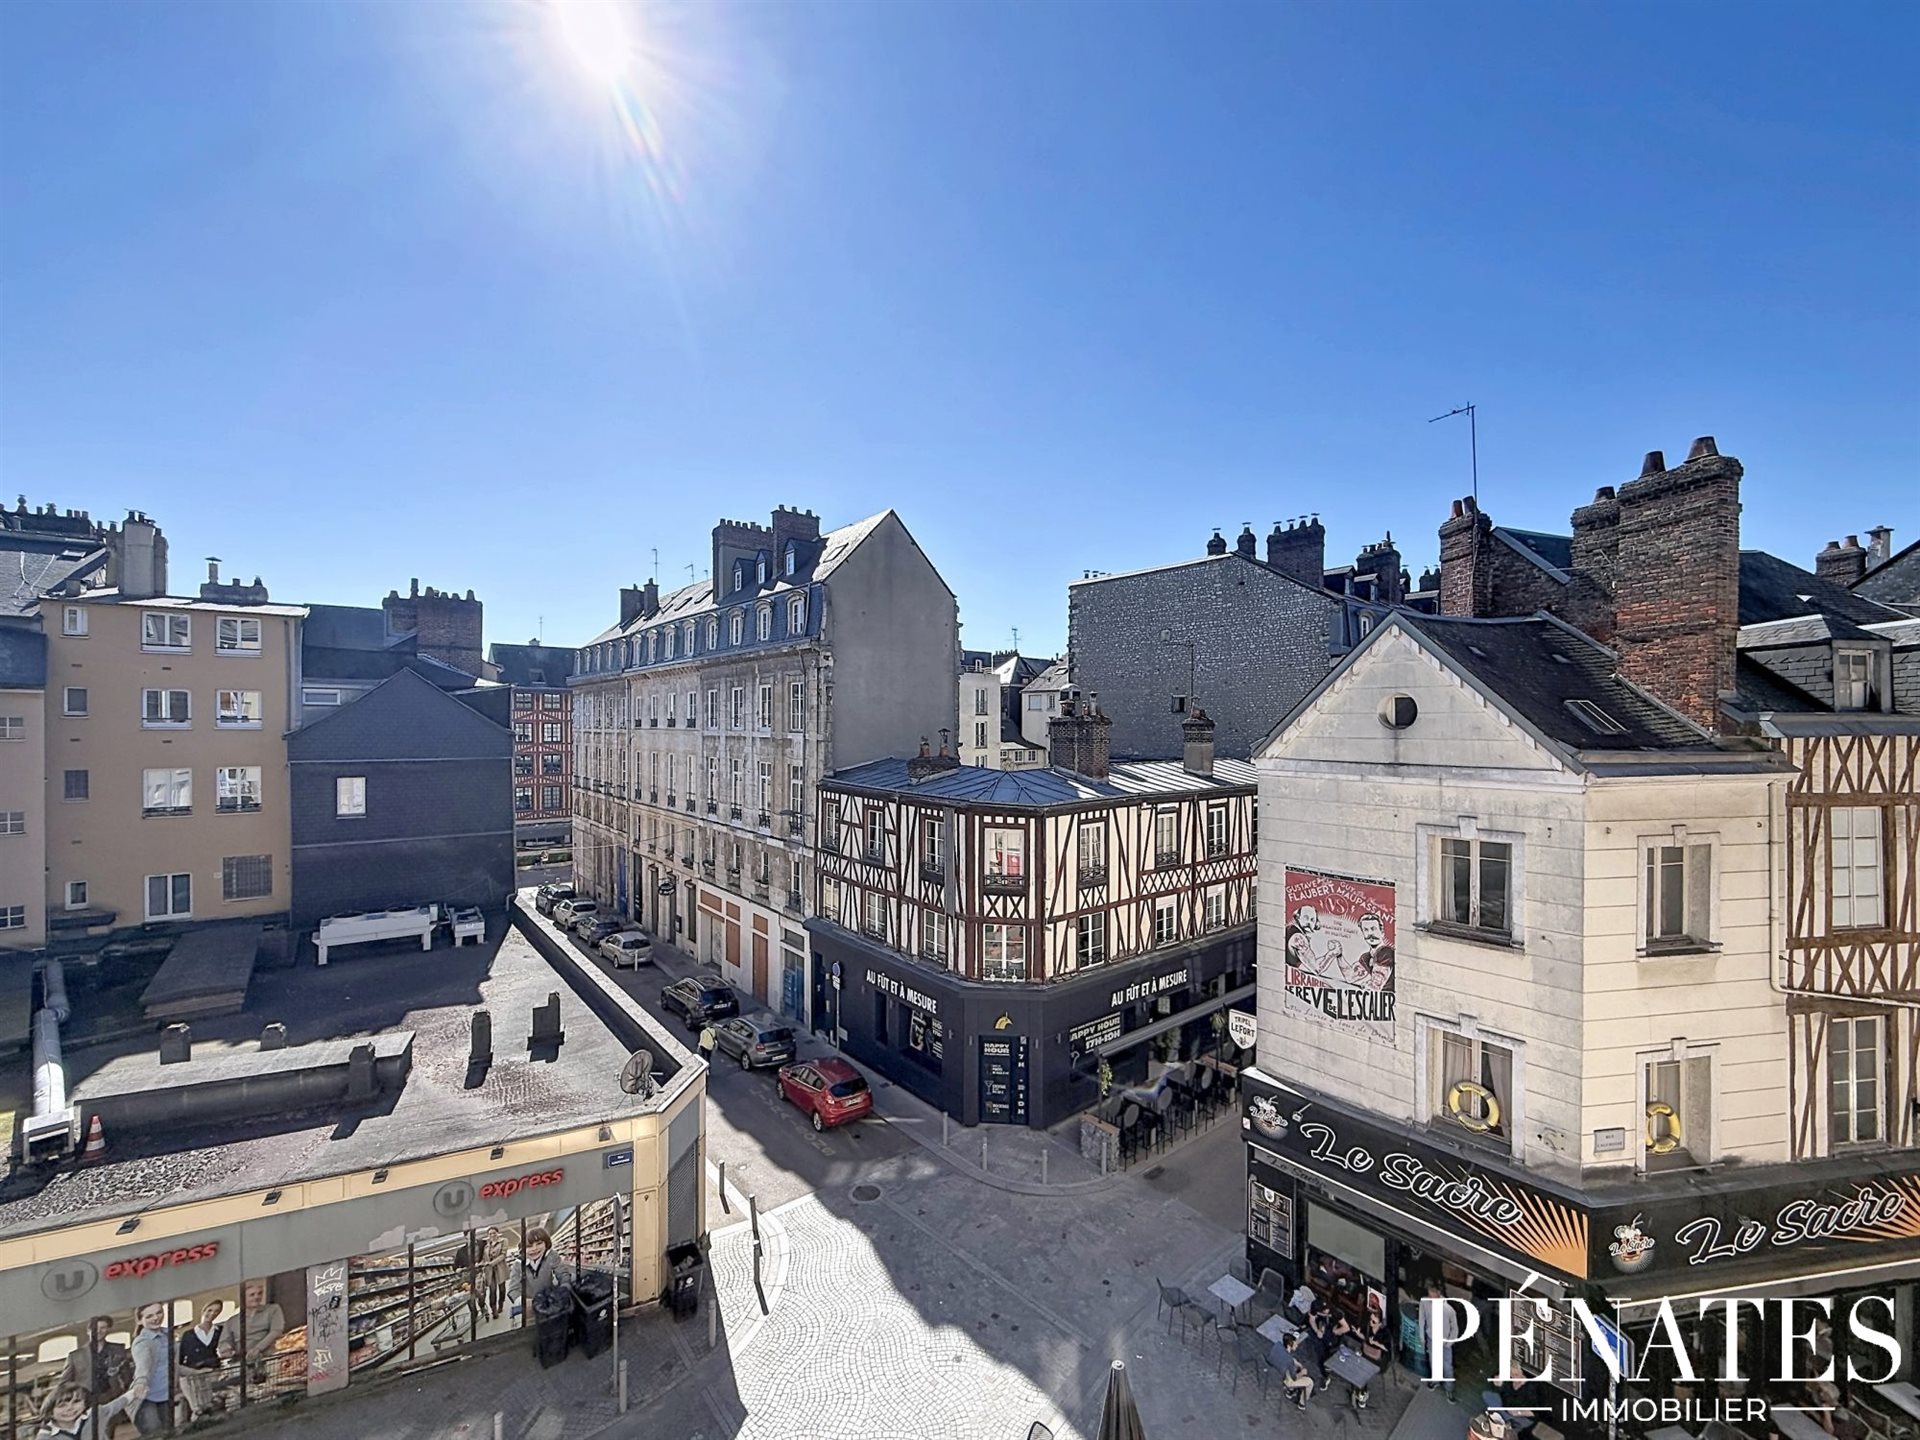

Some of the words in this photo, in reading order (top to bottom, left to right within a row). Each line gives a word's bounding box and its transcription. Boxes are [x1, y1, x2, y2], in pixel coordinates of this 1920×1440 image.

[1286, 880, 1317, 893] GUSTAVE
[1288, 883, 1335, 902] FLAUBERT
[1340, 881, 1354, 892] GUY
[1336, 887, 1394, 924] MAUPASSANT
[866, 969, 876, 984] AU
[877, 972, 889, 991] FÛT
[890, 980, 898, 995] ET
[899, 981, 905, 999] À
[906, 987, 936, 1014] MESURE
[1111, 990, 1124, 1007] AU
[1126, 984, 1140, 1002] FÛT
[1141, 982, 1150, 997] ET
[1151, 977, 1157, 993] À
[1158, 969, 1187, 990] MESURE
[1285, 986, 1294, 995] LE
[1337, 989, 1396, 1021] L'ESCALIER
[479, 1167, 565, 1200] express
[1300, 1123, 1374, 1172] Le
[1379, 1153, 1523, 1225] Sacre
[1675, 1217, 1767, 1266] Le
[1771, 1187, 1905, 1246] Sacre
[104, 1241, 220, 1280] express
